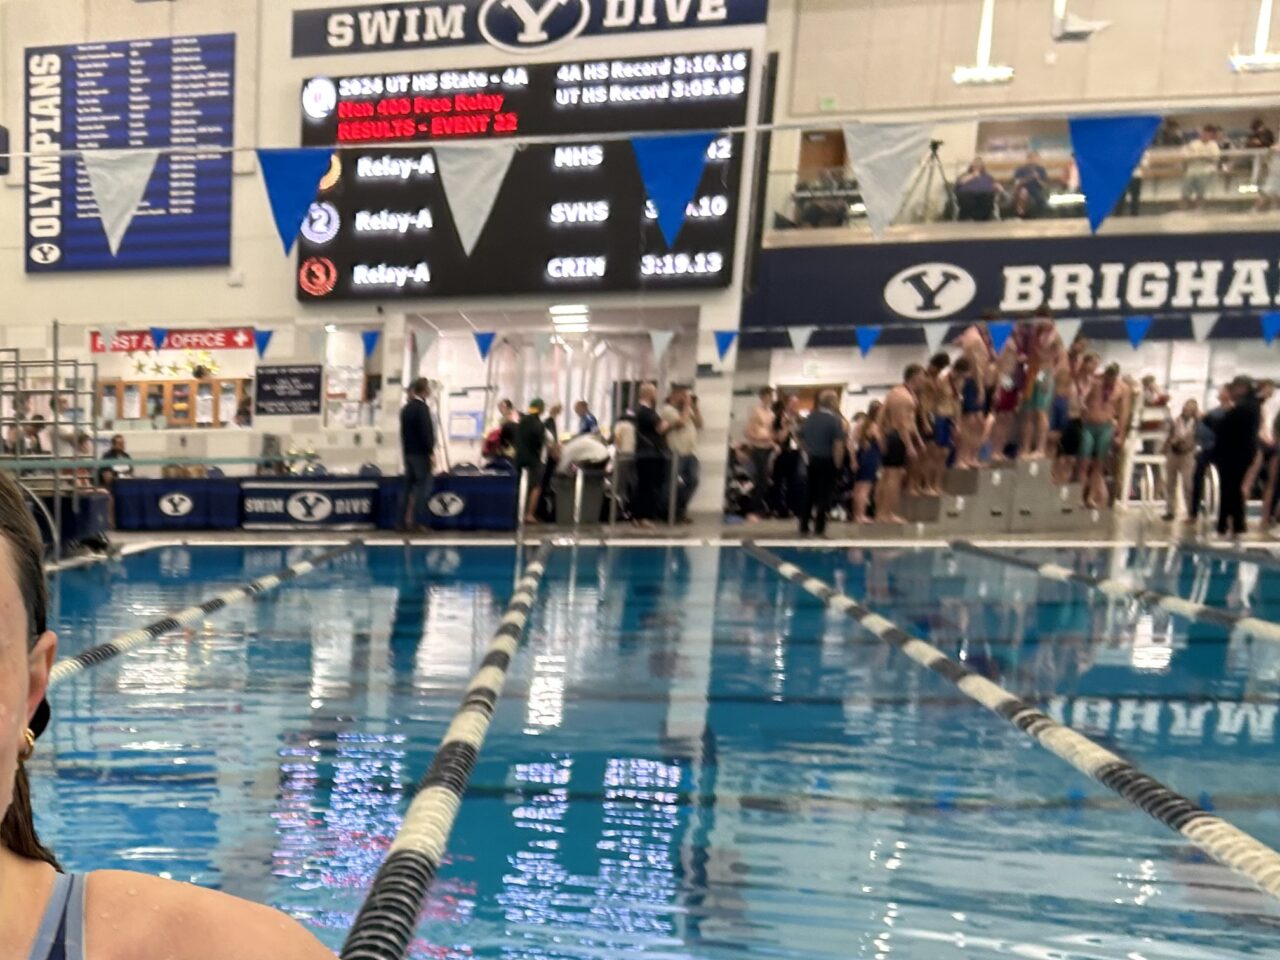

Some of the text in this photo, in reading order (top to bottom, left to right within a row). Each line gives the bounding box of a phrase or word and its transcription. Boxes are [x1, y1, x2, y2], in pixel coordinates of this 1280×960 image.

[327, 6, 466, 47] SWIM
[603, 0, 728, 27] DIVE
[339, 77, 383, 96] 2024
[385, 74, 410, 92] UT
[412, 73, 438, 91] HS
[440, 71, 488, 90] State
[502, 67, 528, 85] 4A
[556, 64, 582, 81] 4A
[583, 61, 609, 80] HS
[611, 57, 671, 79] Record
[377, 98, 411, 116] 400
[414, 96, 452, 114] Free
[455, 93, 504, 112] Relay
[556, 88, 581, 105] UT
[582, 86, 607, 103] HS
[609, 81, 669, 102] Record
[338, 118, 415, 140] RESULTS
[432, 113, 490, 135] EVENT
[29, 53, 61, 238] OLYMPIANS
[356, 145, 604, 179] Relay-A MHS
[354, 207, 433, 233] Relay-A
[550, 200, 609, 223] SVHS
[352, 262, 431, 287] Relay-A
[999, 259, 1280, 312] BRIGHA
[171, 333, 226, 348] OFFICE
[244, 497, 284, 513] SWIM
